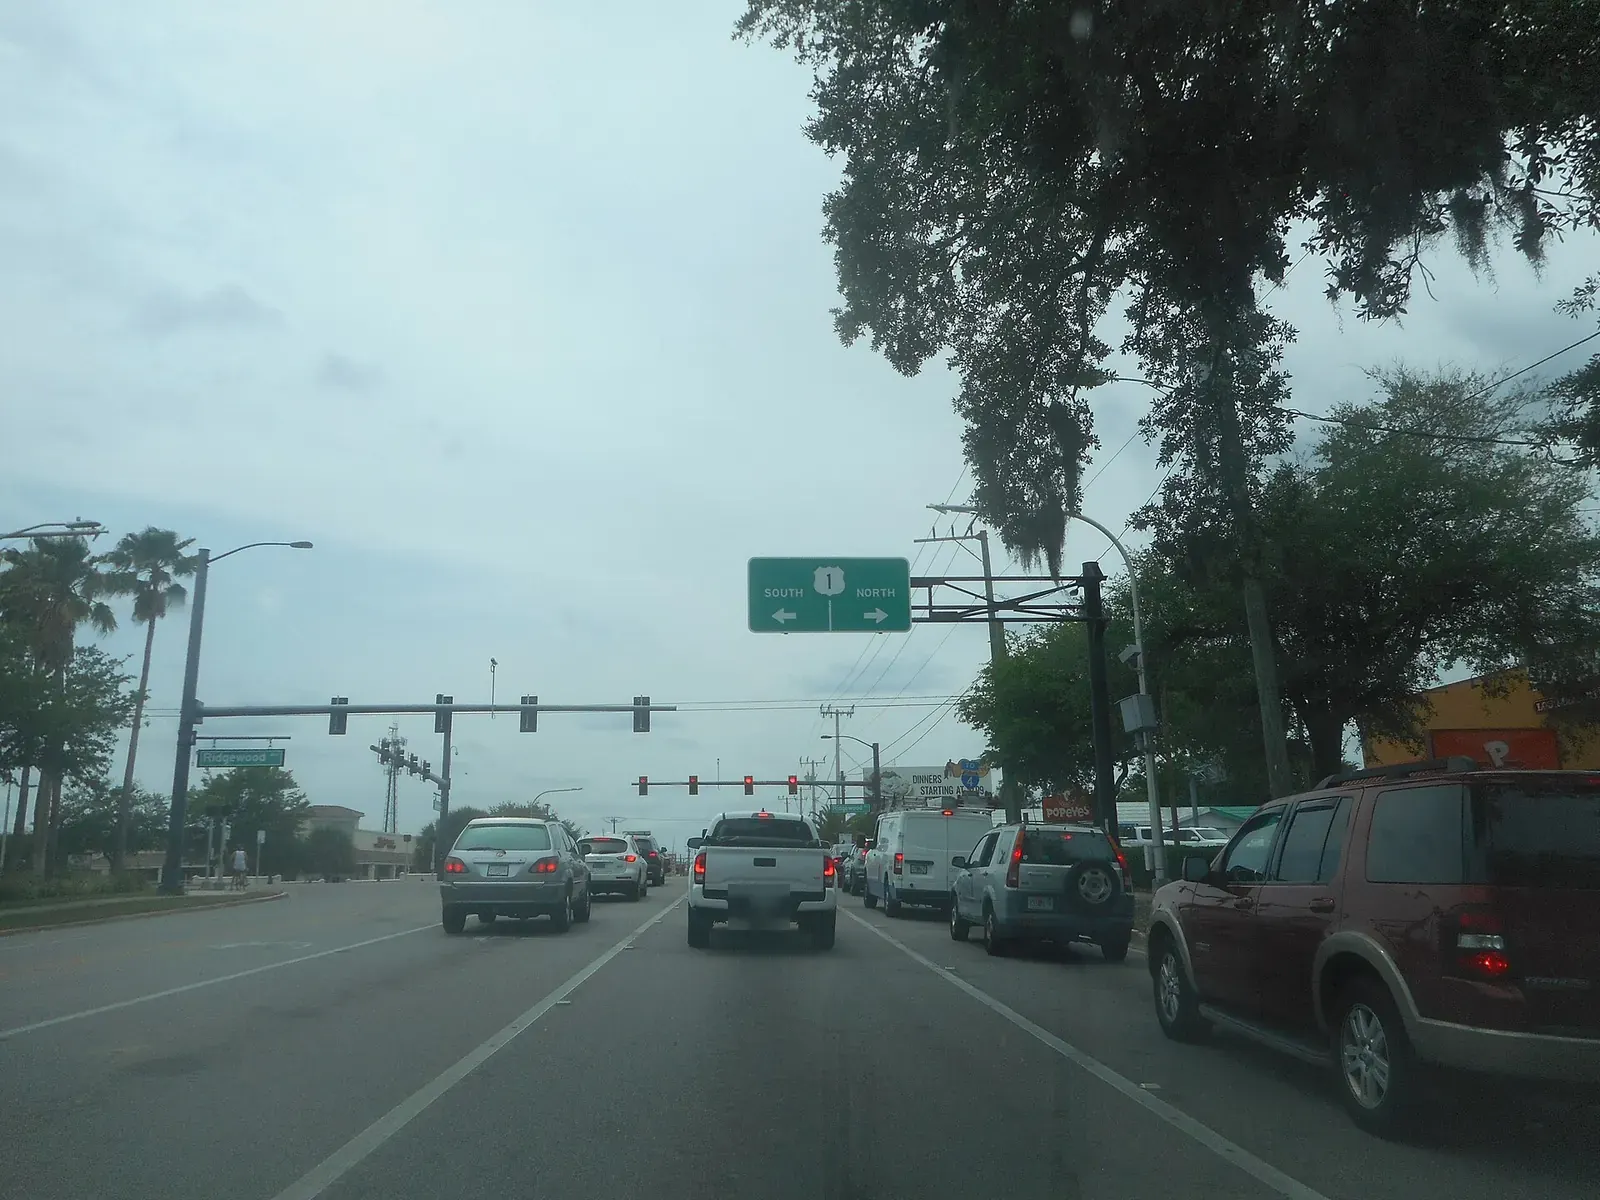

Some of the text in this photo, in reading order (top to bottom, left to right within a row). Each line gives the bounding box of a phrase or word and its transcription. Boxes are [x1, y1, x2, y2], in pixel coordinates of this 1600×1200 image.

[826, 574, 832, 589] 1
[764, 588, 804, 598] SOUTH
[856, 588, 896, 598] NORTH
[203, 752, 267, 765] Ridgewood
[912, 774, 942, 784] DINNERS
[920, 785, 954, 795] STARTING
[956, 785, 964, 795] AT
